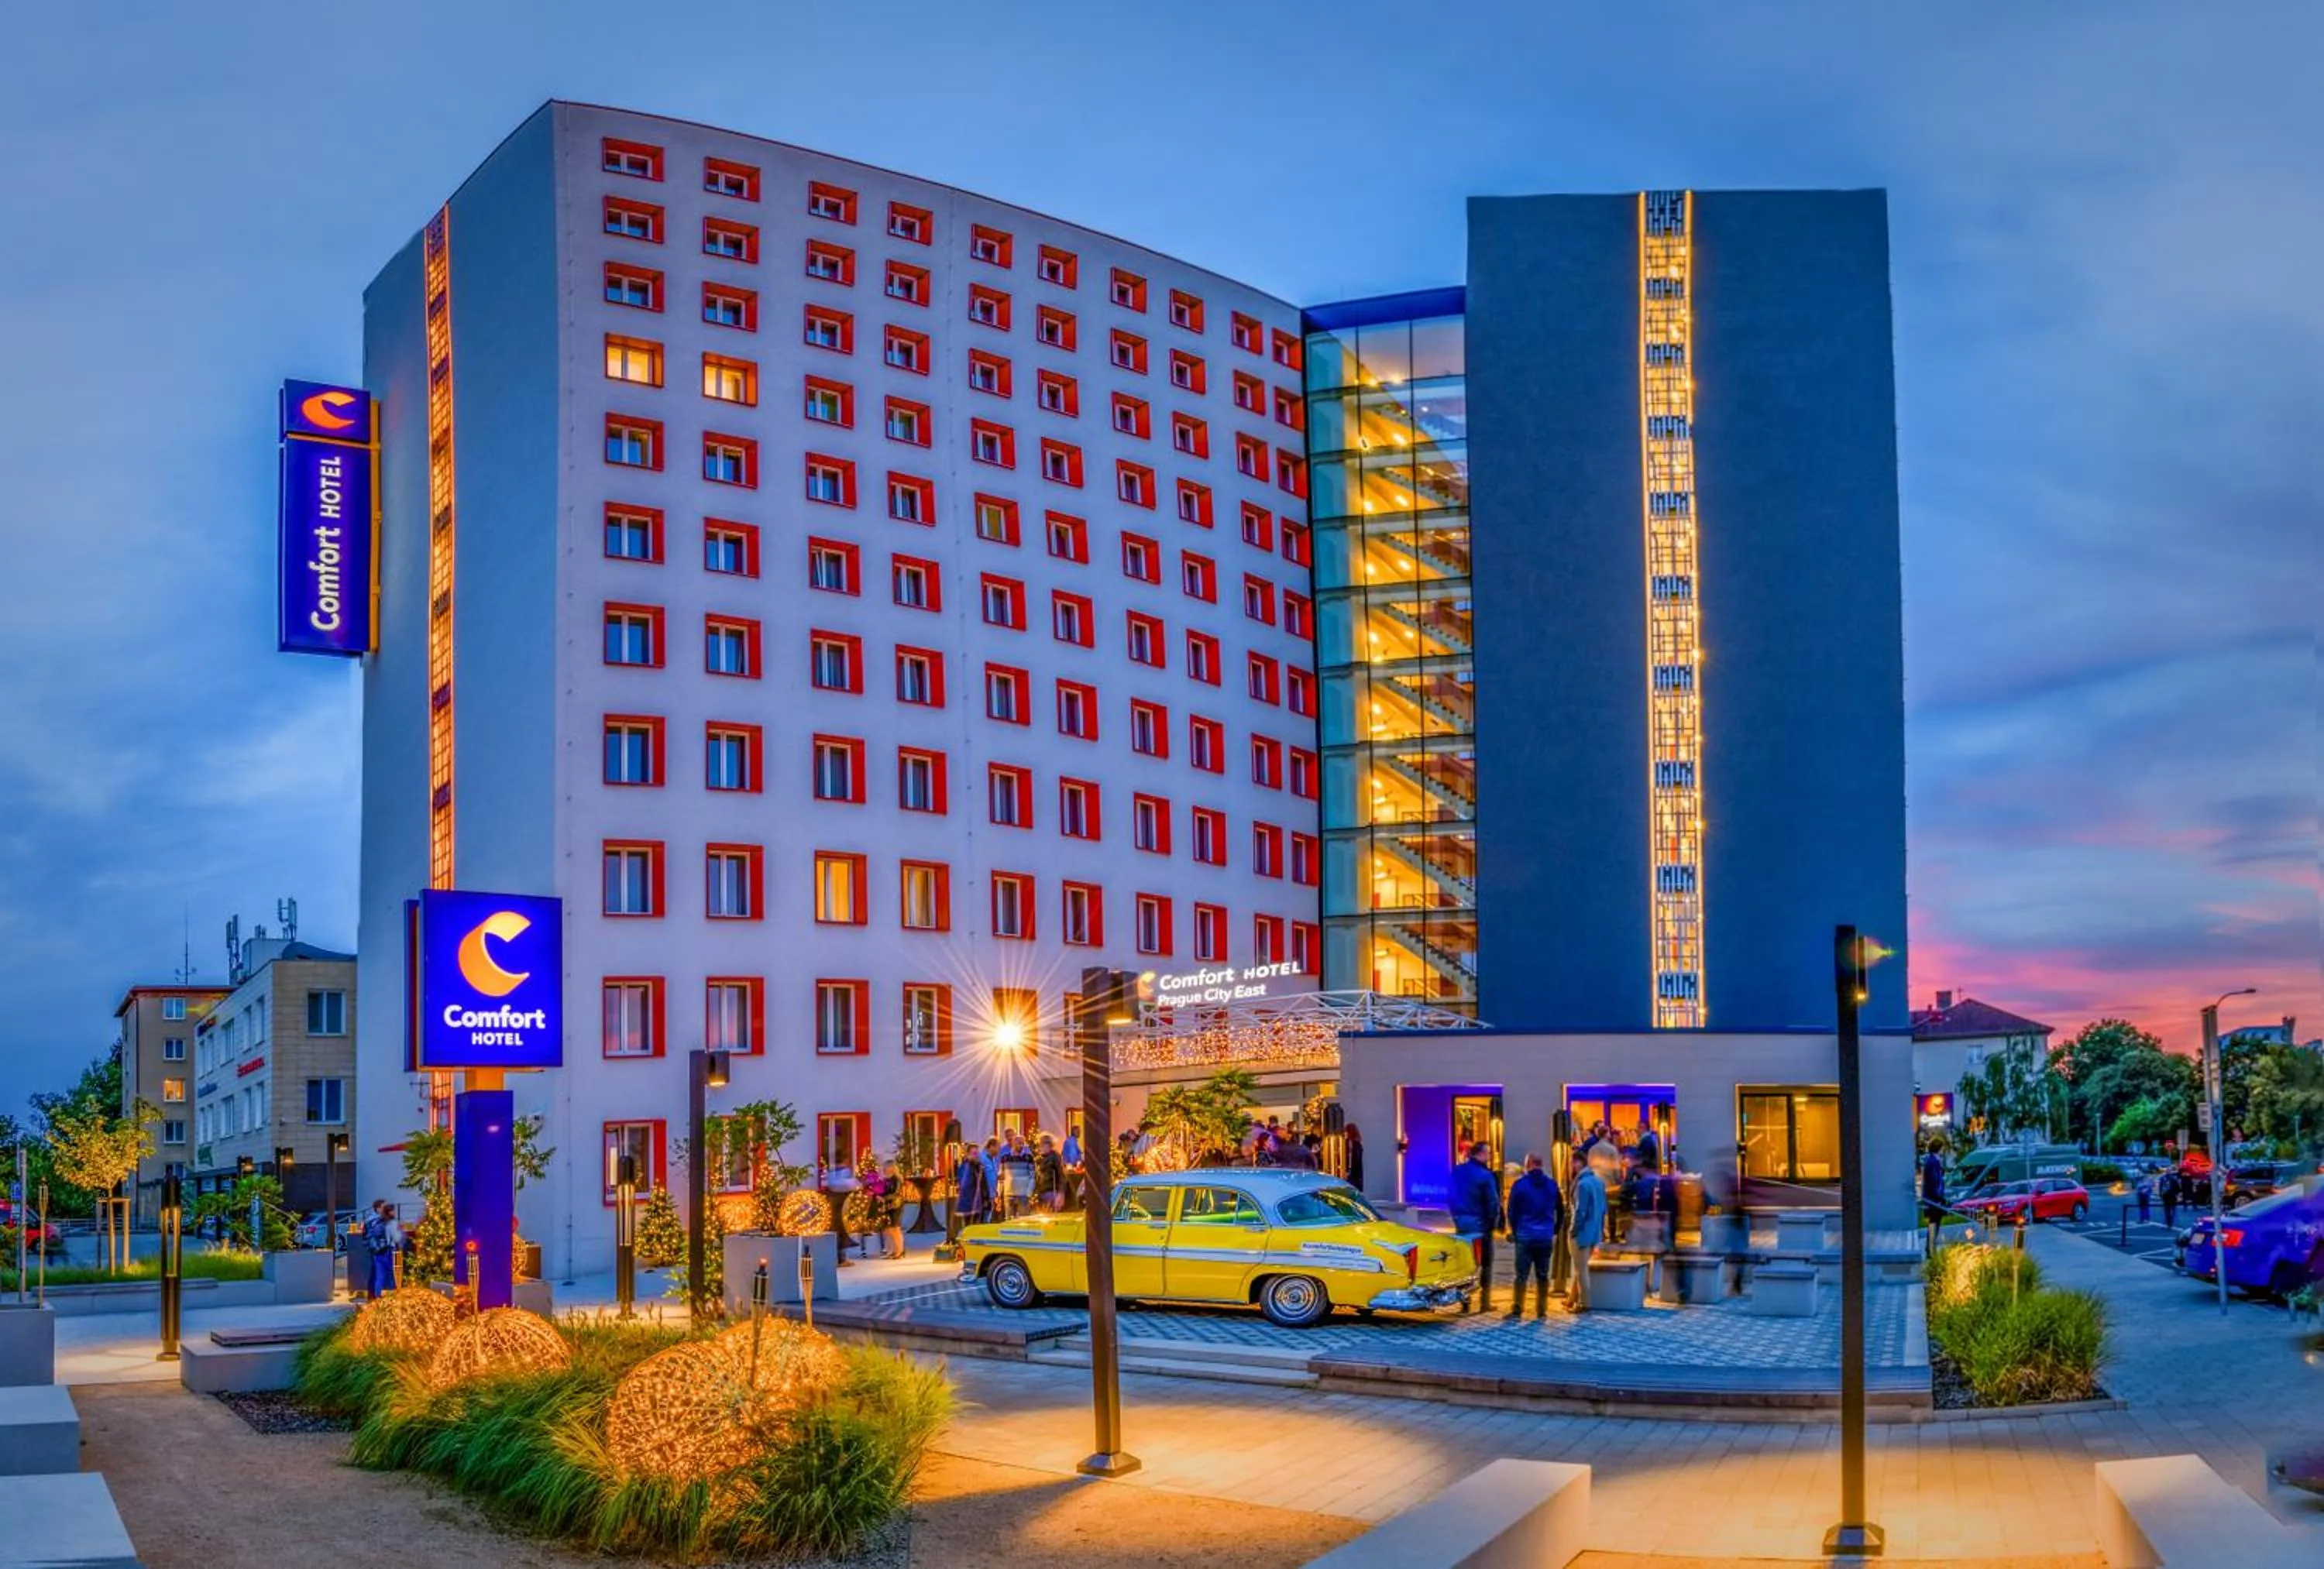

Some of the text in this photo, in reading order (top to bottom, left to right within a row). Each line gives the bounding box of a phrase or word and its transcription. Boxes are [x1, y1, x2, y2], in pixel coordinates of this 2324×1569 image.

[308, 455, 342, 631] Comfort HOTEL
[1159, 961, 1302, 990] Comfort HOTEL
[1157, 984, 1267, 1008] Prague City East
[443, 1004, 546, 1029] Comfort
[471, 1032, 524, 1046] HOTEL
